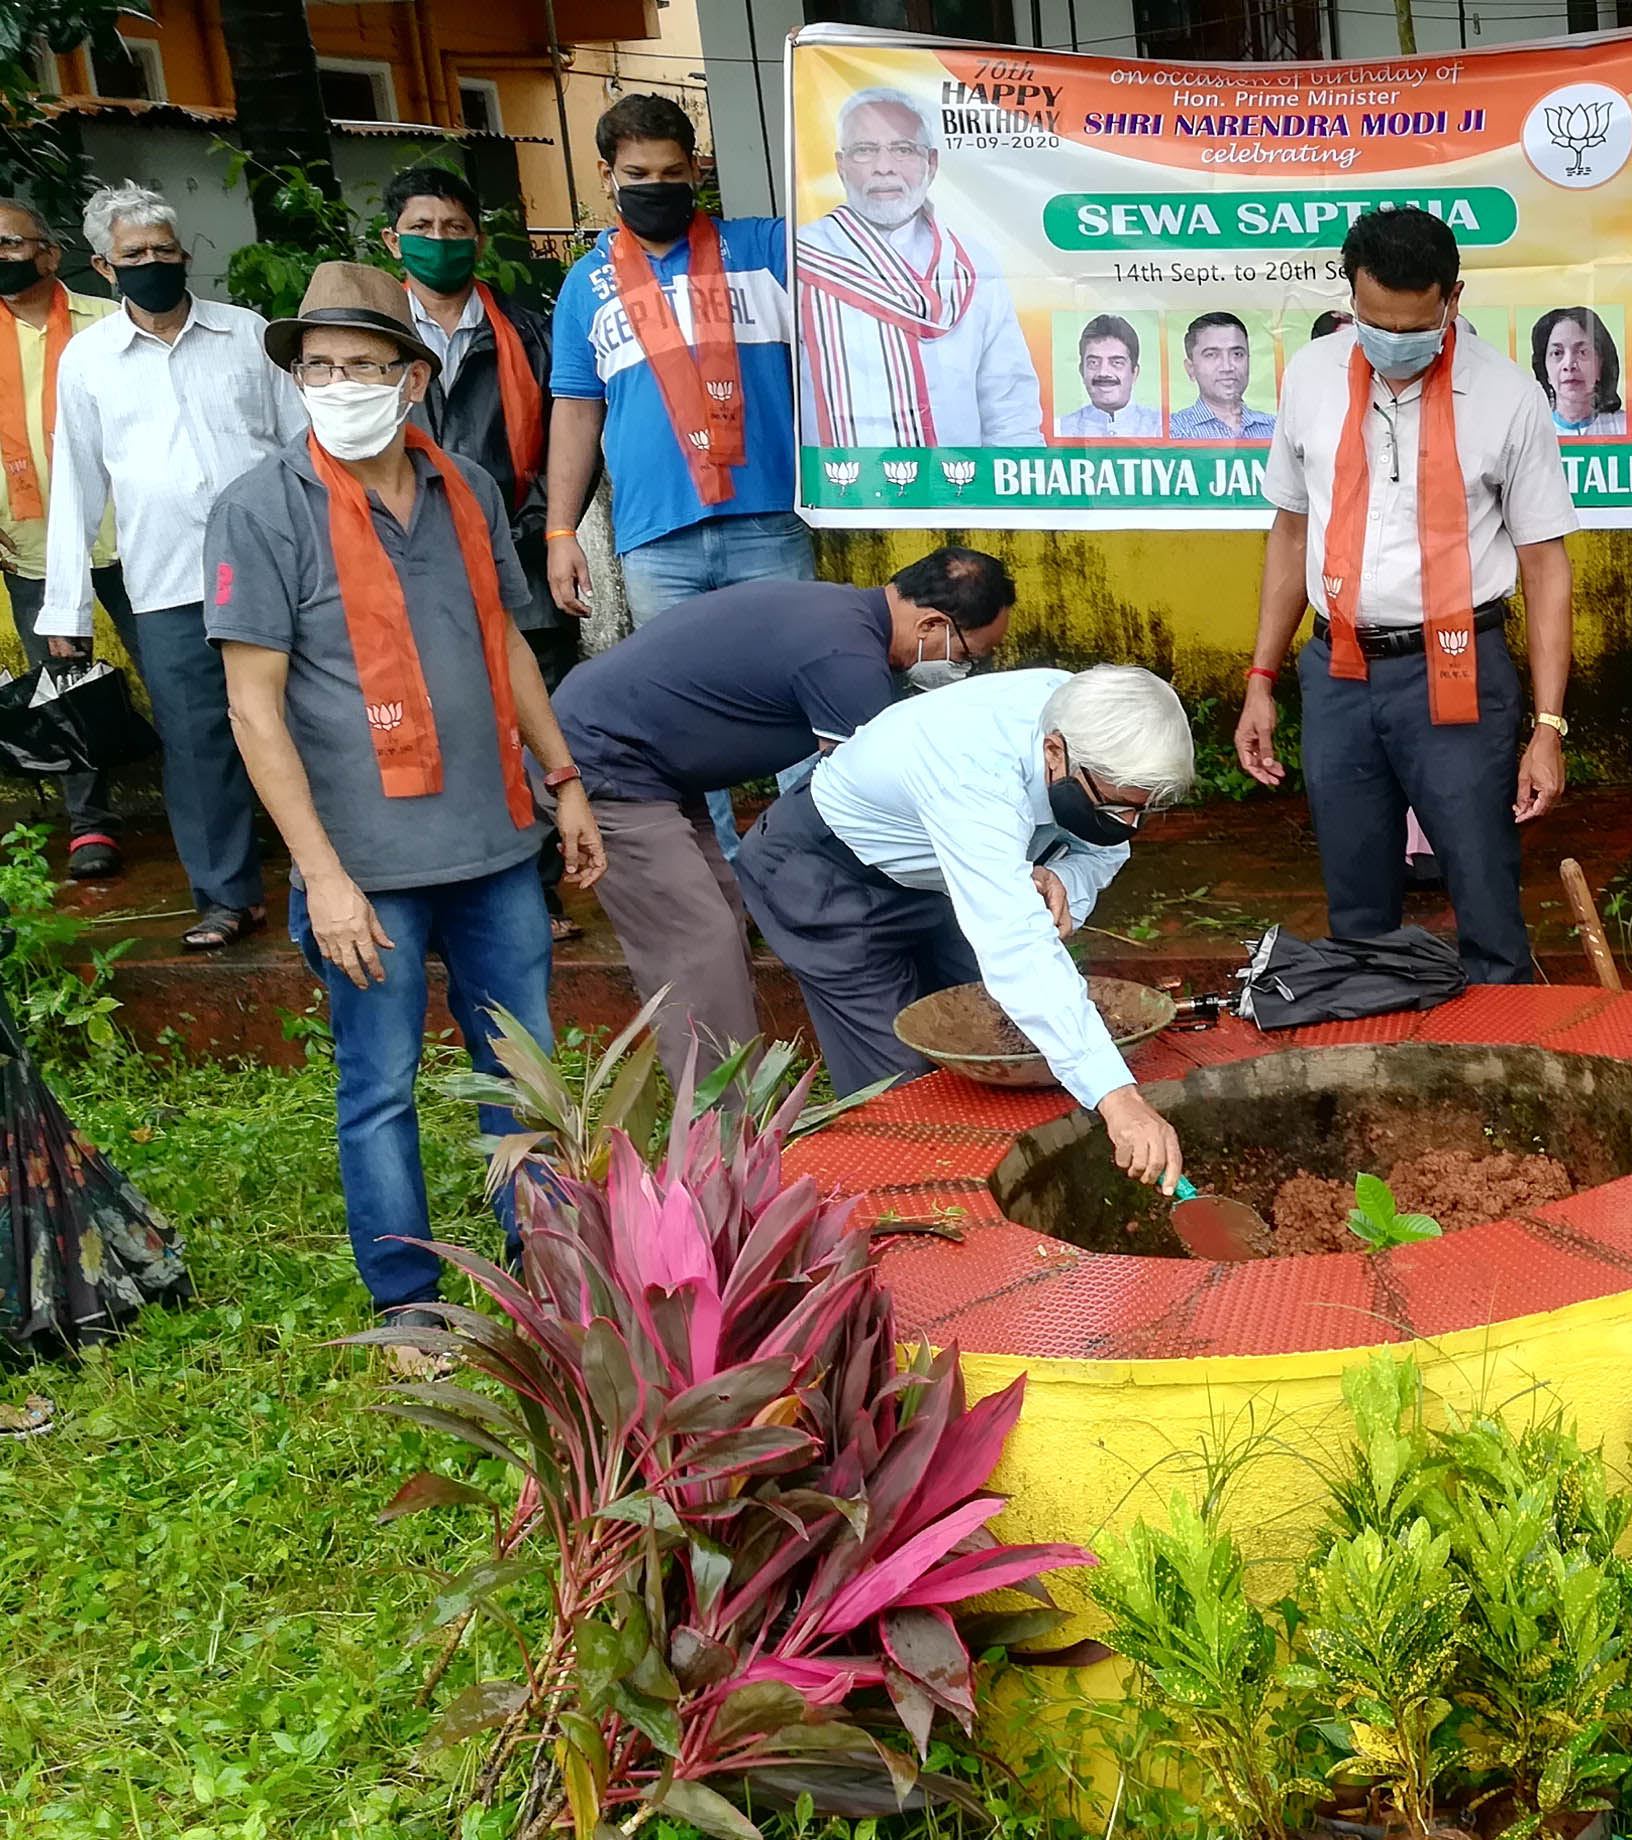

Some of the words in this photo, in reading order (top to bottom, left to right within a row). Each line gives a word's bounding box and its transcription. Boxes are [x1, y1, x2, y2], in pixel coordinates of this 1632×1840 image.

[974, 59, 1035, 81] 70th
[1110, 69, 1150, 85] on
[1153, 70, 1270, 88] occasion
[1310, 64, 1428, 88] birthday
[1436, 60, 1465, 84] of
[942, 81, 1063, 107] HAPPY
[1172, 90, 1226, 107] Hon.
[1235, 90, 1299, 107] Prime
[1307, 89, 1400, 107] Minister
[942, 109, 1060, 134] BIRTHDAY
[1084, 112, 1165, 136] SHRI
[1174, 113, 1350, 137] NARENDRA
[1361, 111, 1448, 137] MODI
[1457, 109, 1486, 133] JI
[945, 136, 1060, 149] 17-09-2020
[1201, 142, 1362, 168] celebrating
[1077, 203, 1221, 236] SEWA
[589, 263, 621, 299] 53
[1113, 263, 1163, 282] 14th
[1171, 262, 1226, 286] Sept.
[1234, 264, 1256, 281] to
[1265, 261, 1316, 281] 20th
[688, 286, 756, 325] REAL
[993, 458, 1200, 496] BHARATIYA
[1208, 458, 1268, 496] JAN
